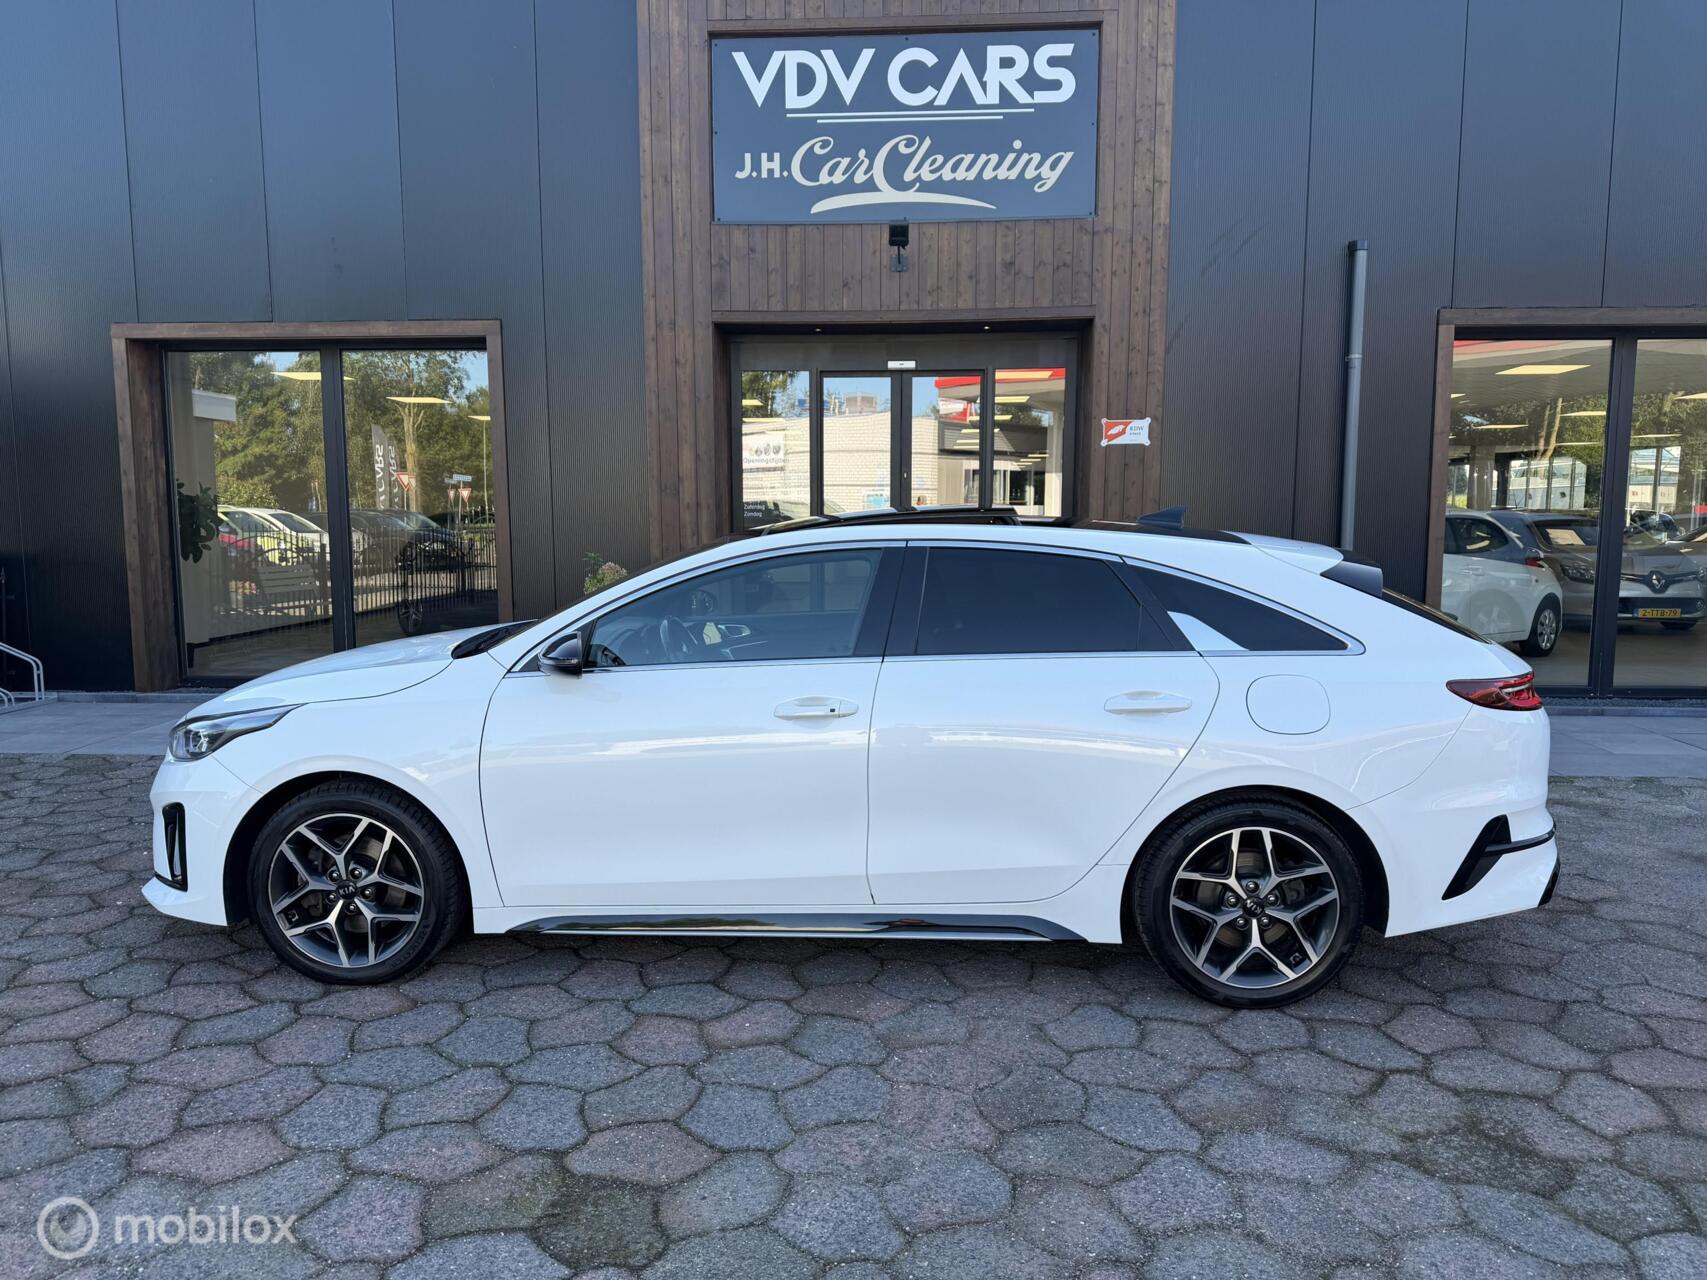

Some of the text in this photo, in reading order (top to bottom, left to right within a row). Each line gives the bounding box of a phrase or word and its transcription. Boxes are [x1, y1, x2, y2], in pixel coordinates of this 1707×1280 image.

[731, 43, 1076, 109] VDV CARS
[339, 886, 355, 896] KIA
